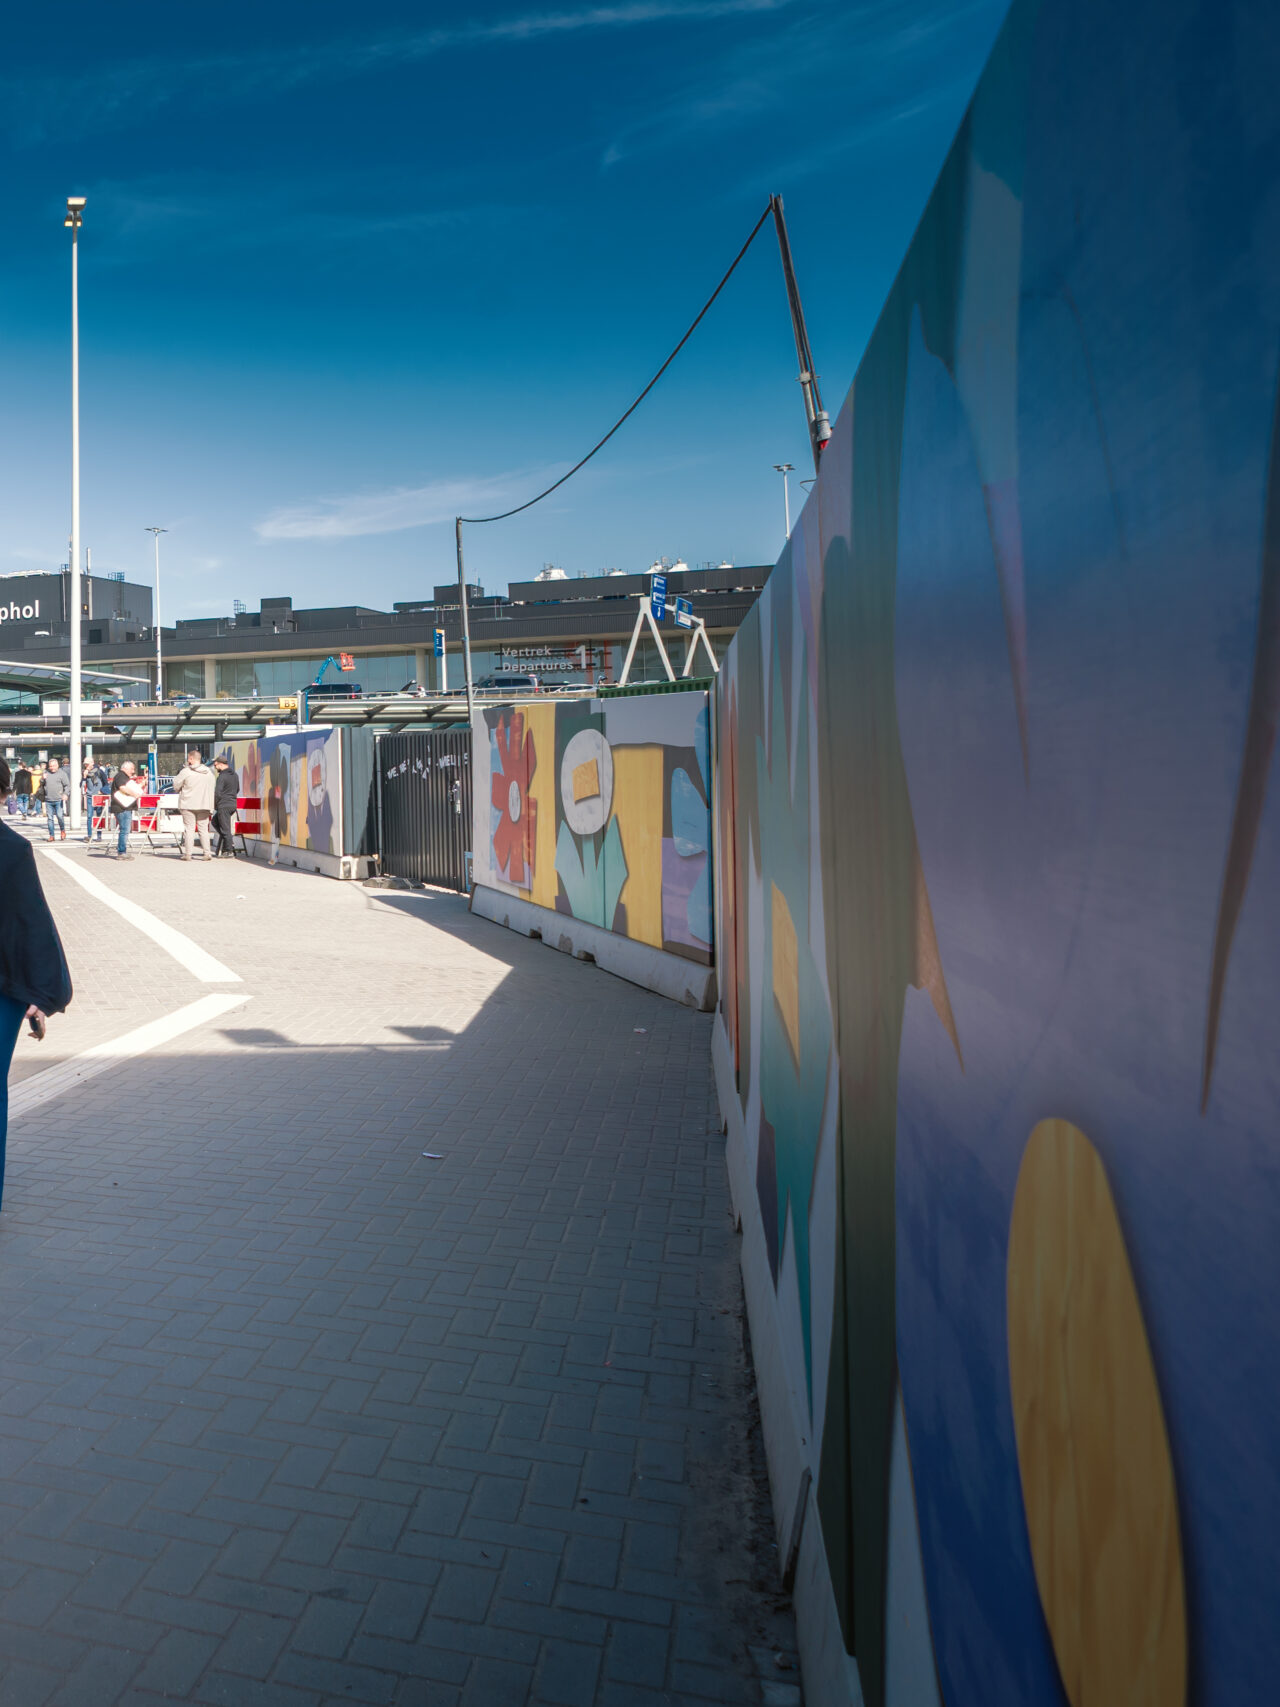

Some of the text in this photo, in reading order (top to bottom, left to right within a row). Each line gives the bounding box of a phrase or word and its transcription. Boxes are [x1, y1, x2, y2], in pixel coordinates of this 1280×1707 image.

[502, 645, 552, 657] Vertrek
[576, 645, 586, 669] 1
[502, 661, 574, 673] Departures
[284, 700, 296, 708] B3
